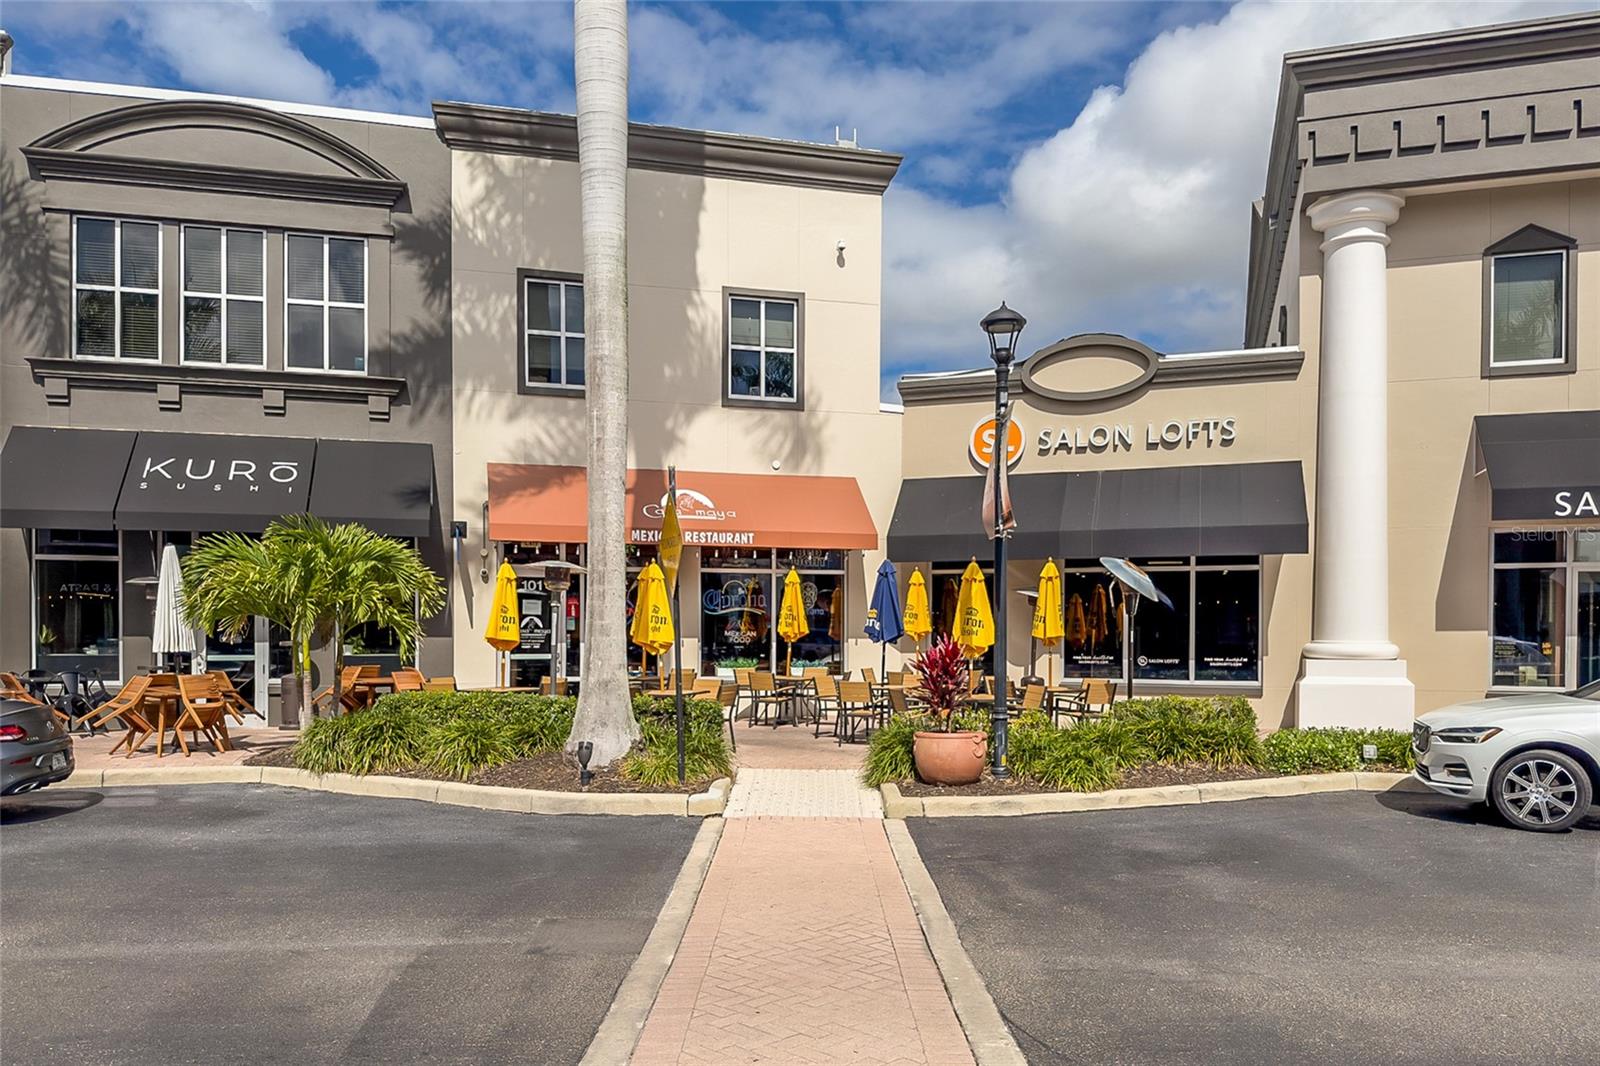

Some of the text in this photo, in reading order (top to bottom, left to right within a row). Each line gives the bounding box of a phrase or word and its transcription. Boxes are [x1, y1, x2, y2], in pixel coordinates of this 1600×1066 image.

[1038, 417, 1237, 450] SALON LOFTS
[139, 481, 293, 494] SUSHI
[642, 504, 737, 520] Caa maya
[631, 529, 755, 544] MEXI RESTAURANT
[521, 580, 543, 591] 101
